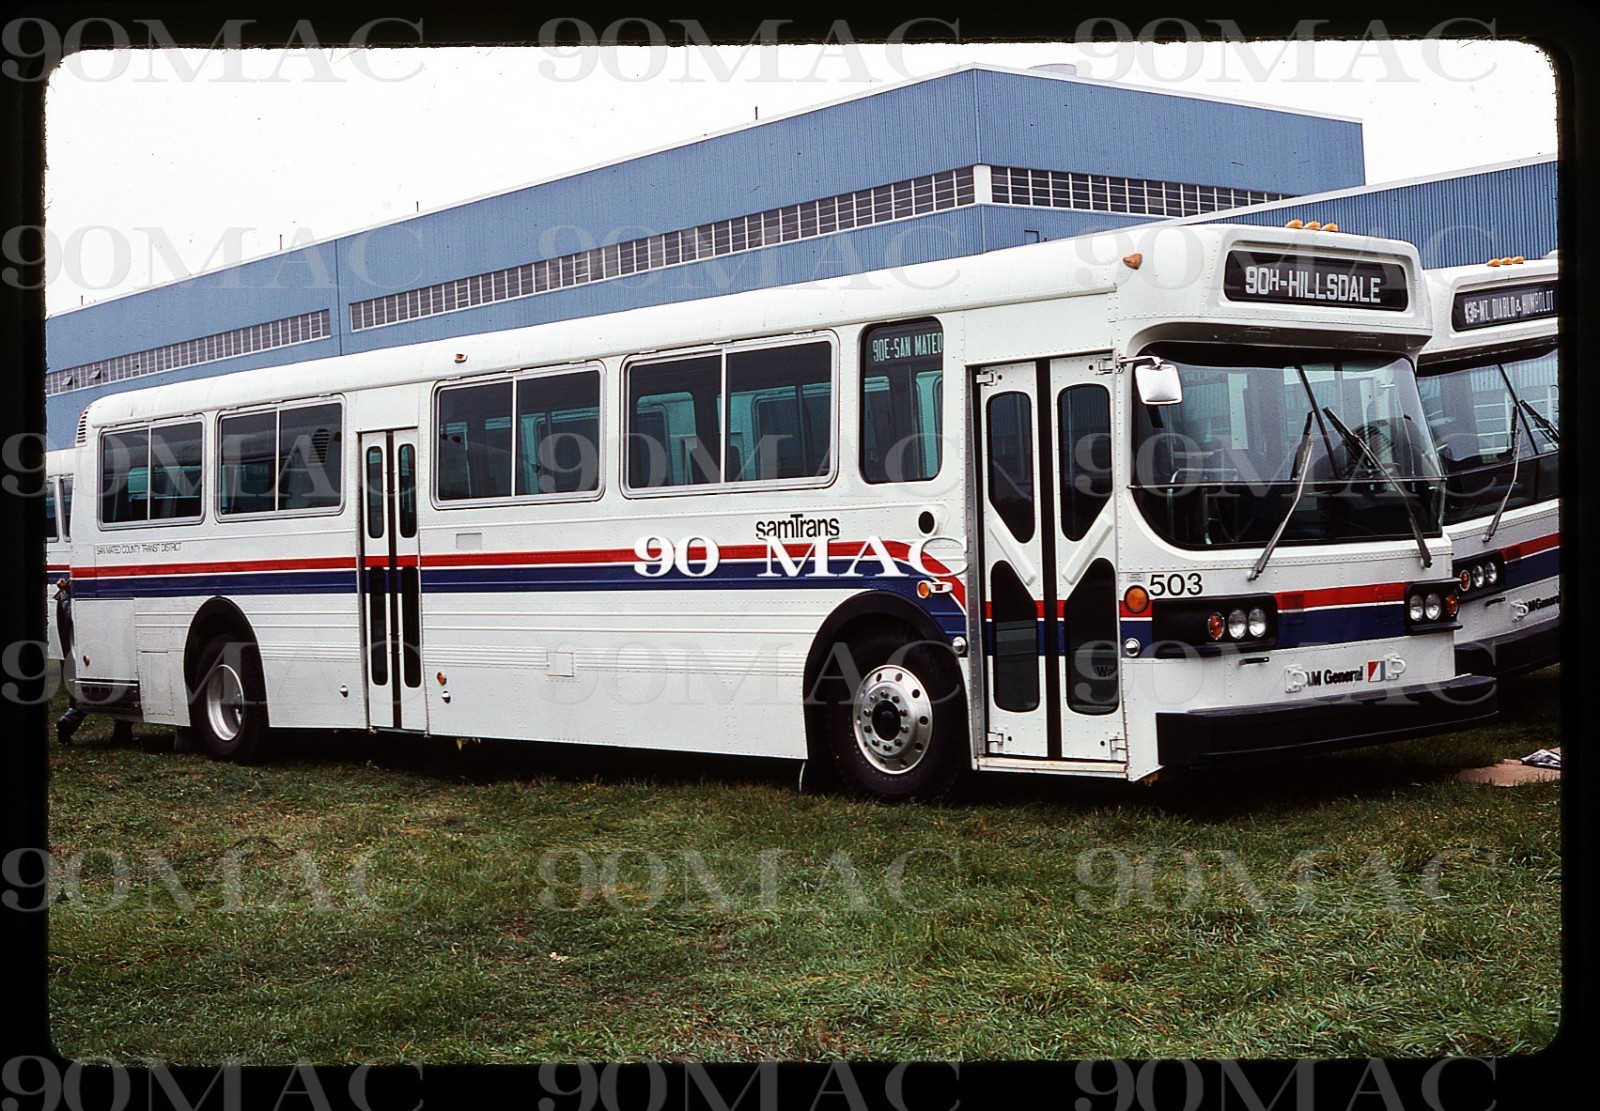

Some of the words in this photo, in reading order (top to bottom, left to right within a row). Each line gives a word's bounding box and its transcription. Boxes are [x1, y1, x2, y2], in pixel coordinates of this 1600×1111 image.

[1245, 266, 1381, 303] 90H-HILLSDALE
[872, 336, 911, 362] 90E-SAN
[915, 332, 943, 356] MATEO
[756, 514, 839, 540] samTrans
[1148, 572, 1203, 596] 503
[1324, 666, 1363, 685] General
